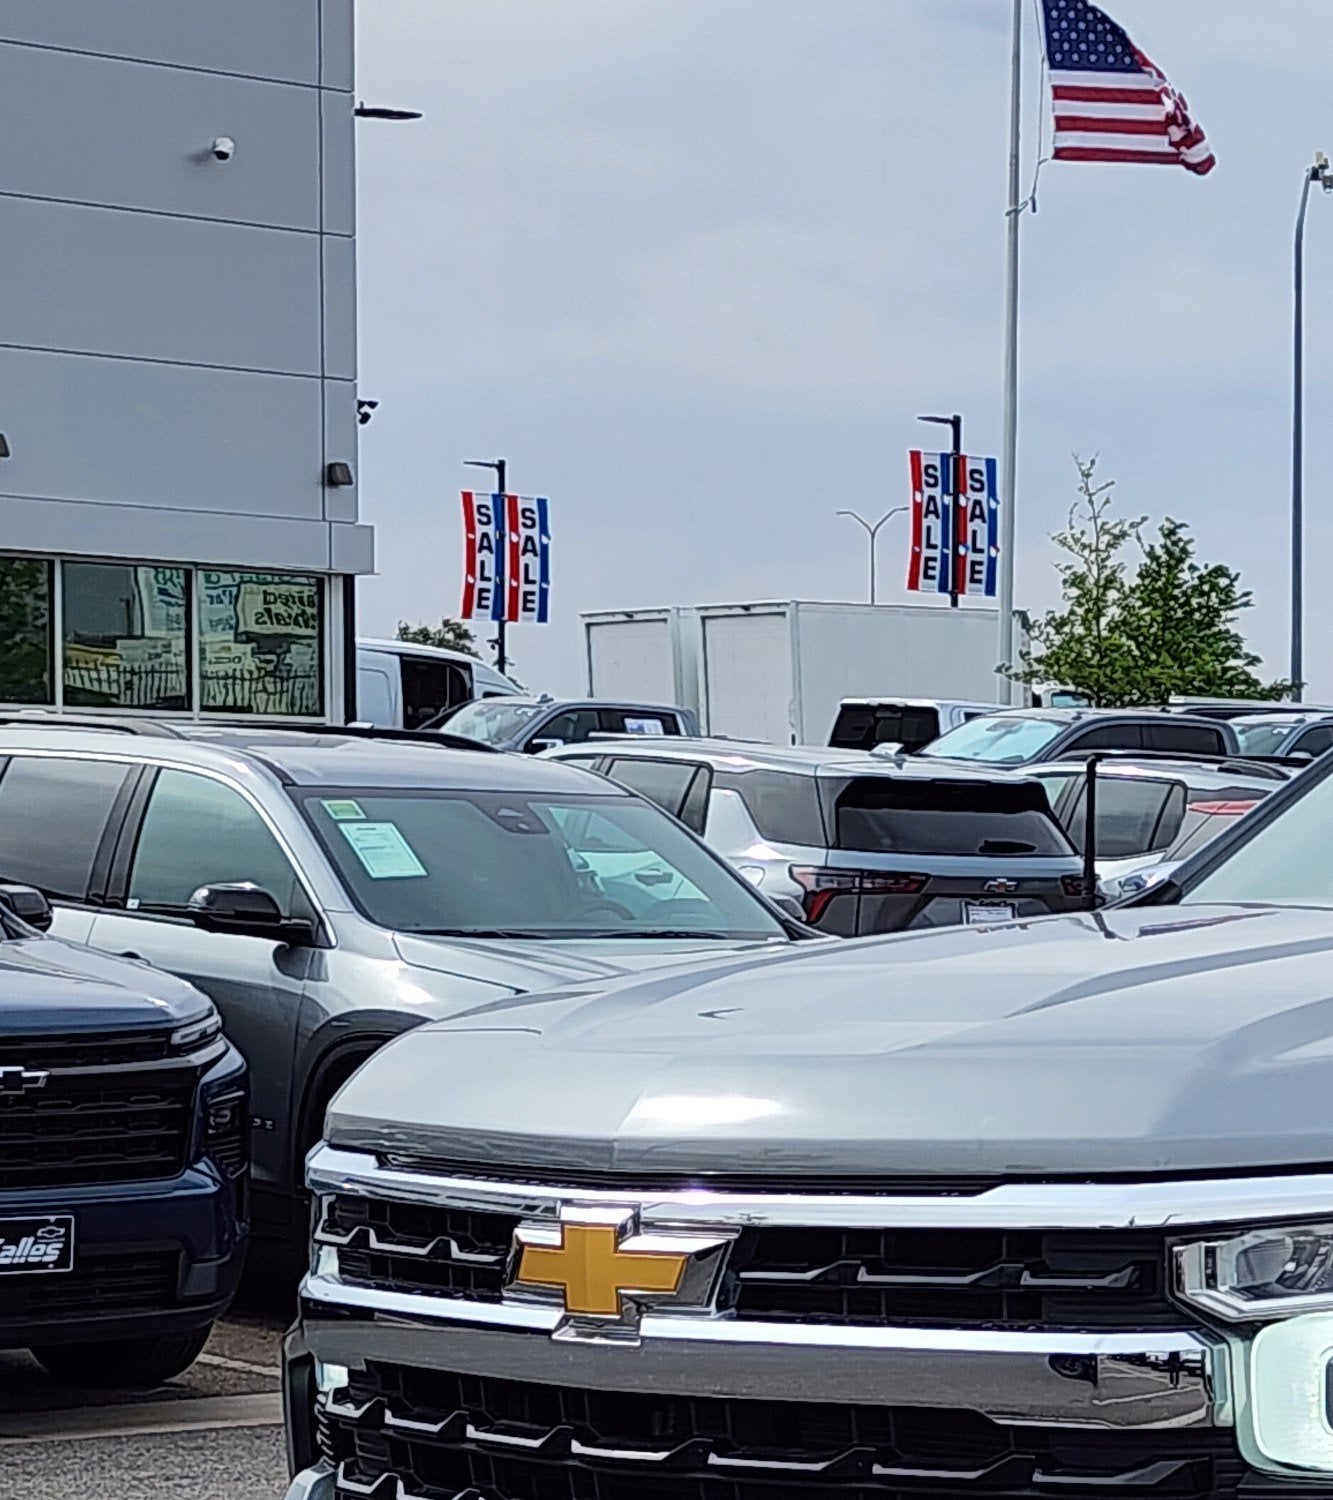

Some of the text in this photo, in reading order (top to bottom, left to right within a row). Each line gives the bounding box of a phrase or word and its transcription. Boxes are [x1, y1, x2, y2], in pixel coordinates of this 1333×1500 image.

[476, 504, 494, 610] SALE
[521, 507, 539, 613] SALE
[923, 464, 940, 580] SALE
[969, 469, 987, 584] SALE
[0, 1237, 65, 1265] alles
